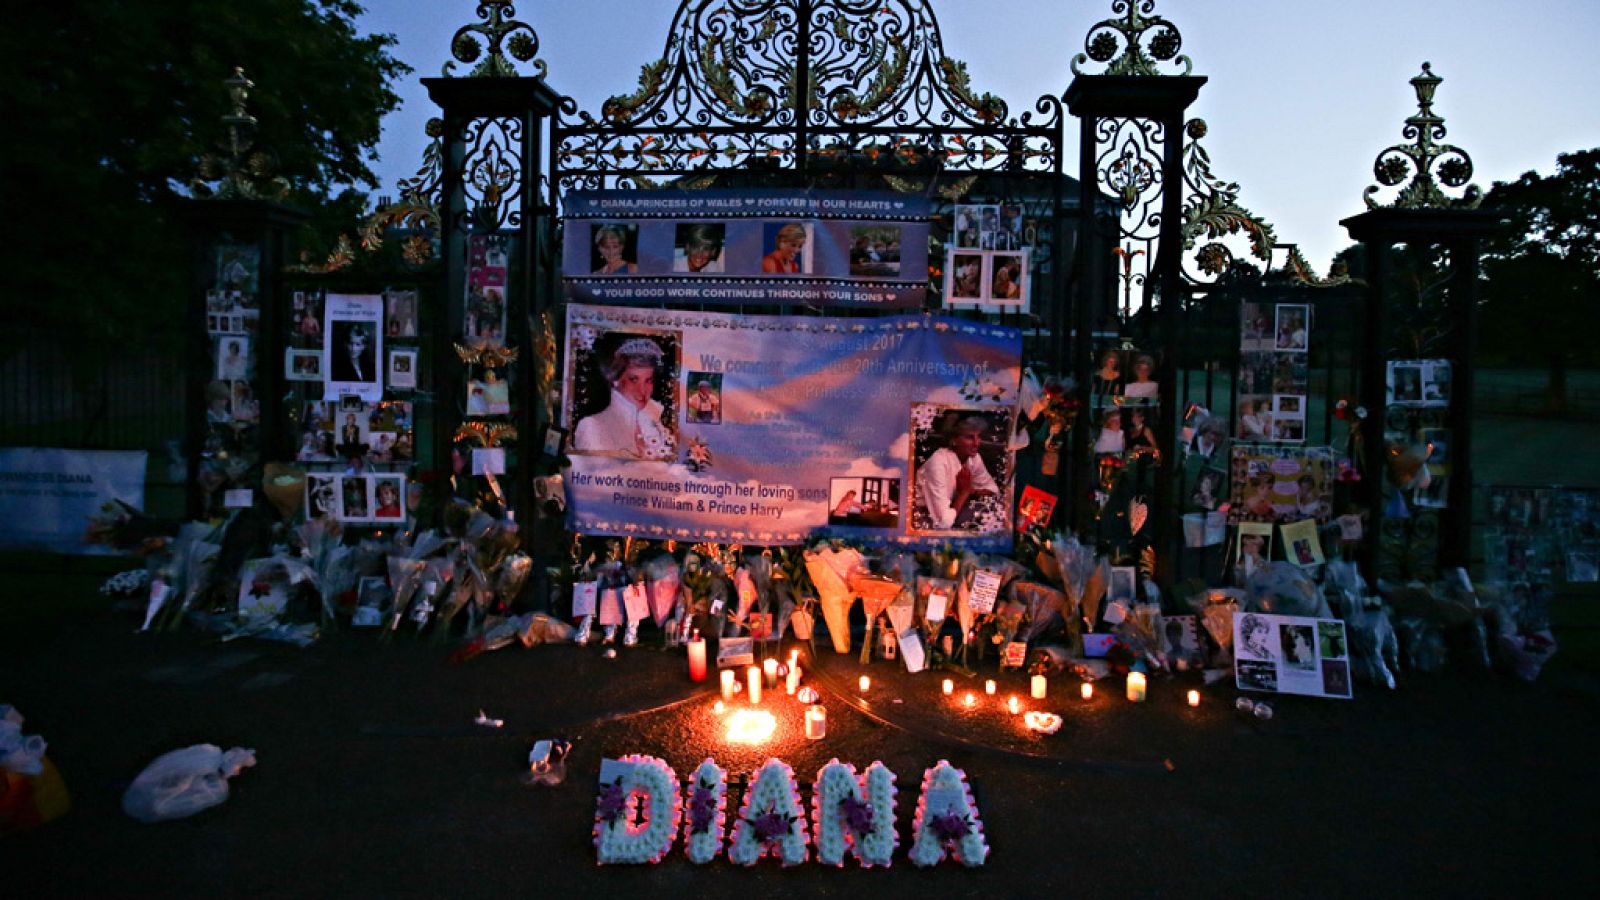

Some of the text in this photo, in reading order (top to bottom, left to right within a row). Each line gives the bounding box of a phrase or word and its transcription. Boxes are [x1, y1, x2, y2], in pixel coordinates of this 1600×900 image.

[690, 199, 704, 208] OF
[706, 199, 742, 208] WALES
[757, 198, 806, 208] FOREVER
[809, 199, 820, 208] IN
[823, 199, 847, 209] OUR
[849, 200, 891, 210] HEARTS
[605, 289, 884, 301] YOUR GOOD WORK CONTINUES THROUGH YOUR SONS
[871, 333, 904, 351] 2017
[700, 353, 721, 371] We
[854, 359, 882, 375] 20th
[888, 359, 971, 380] Anniversary
[974, 360, 990, 376] of
[57, 473, 94, 484] DIANA
[571, 471, 828, 502] Her work continues through her loving sons
[613, 492, 784, 519] Prince William & Prince Harry
[593, 754, 990, 867] DIANA
